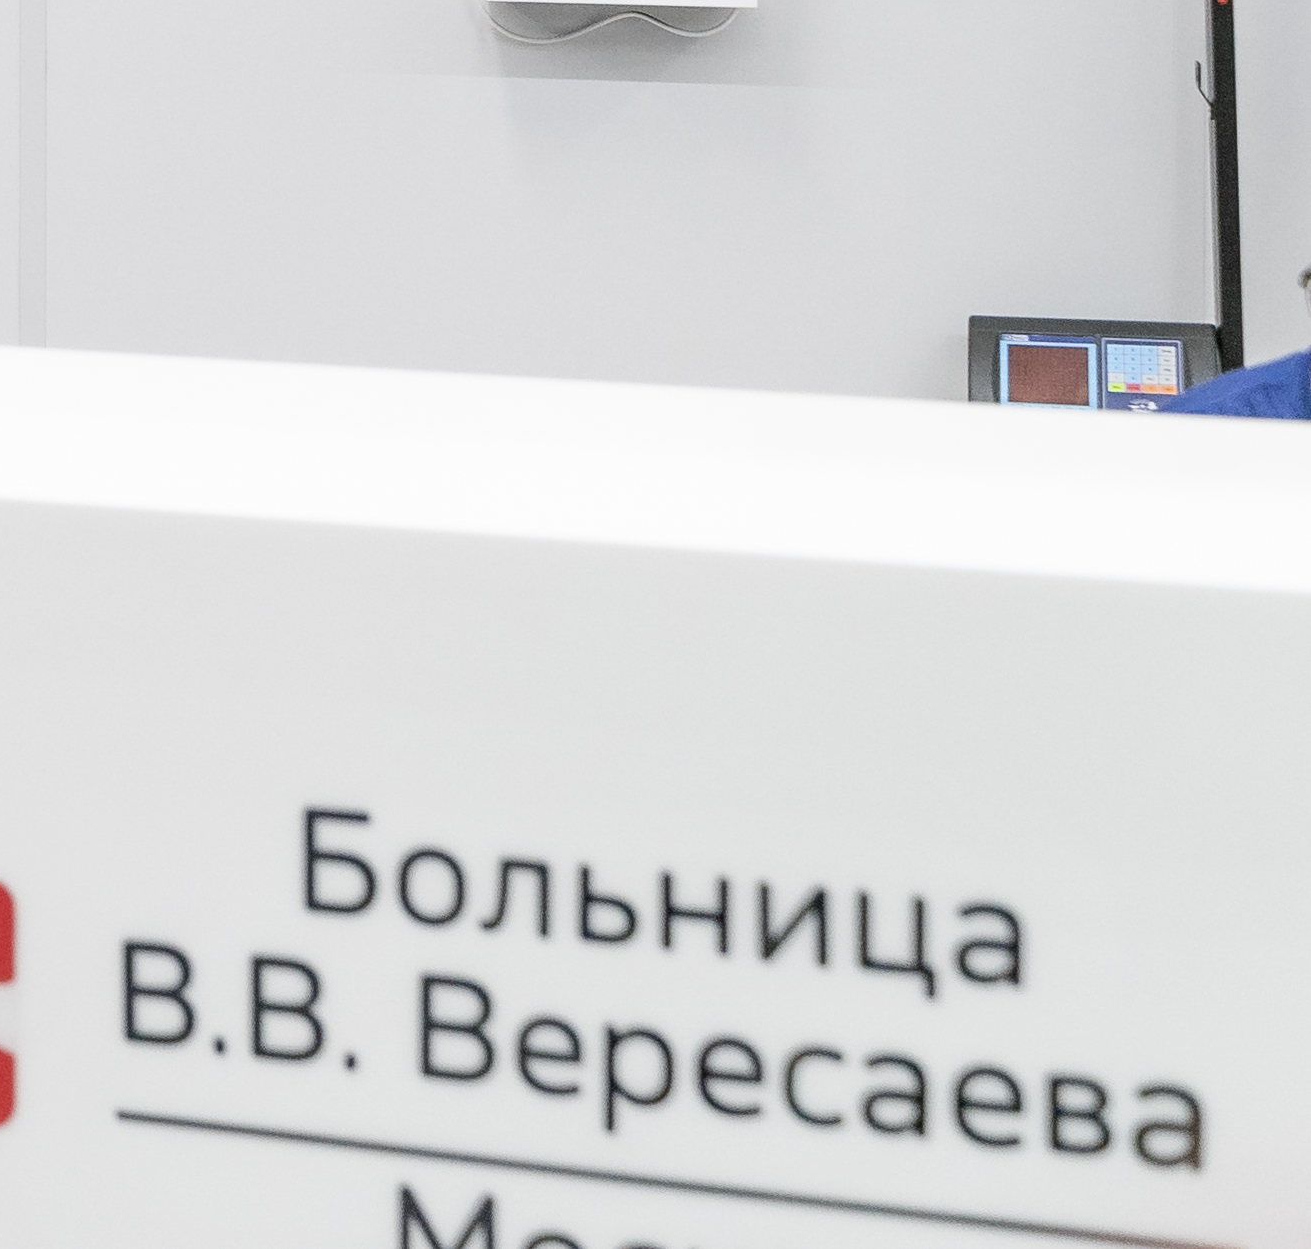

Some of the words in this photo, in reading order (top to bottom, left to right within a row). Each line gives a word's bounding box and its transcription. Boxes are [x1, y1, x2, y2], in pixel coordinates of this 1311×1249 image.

[300, 805, 1026, 1001] Больница
[120, 938, 360, 1073] В.В.
[417, 971, 1206, 1173] Вересаева
